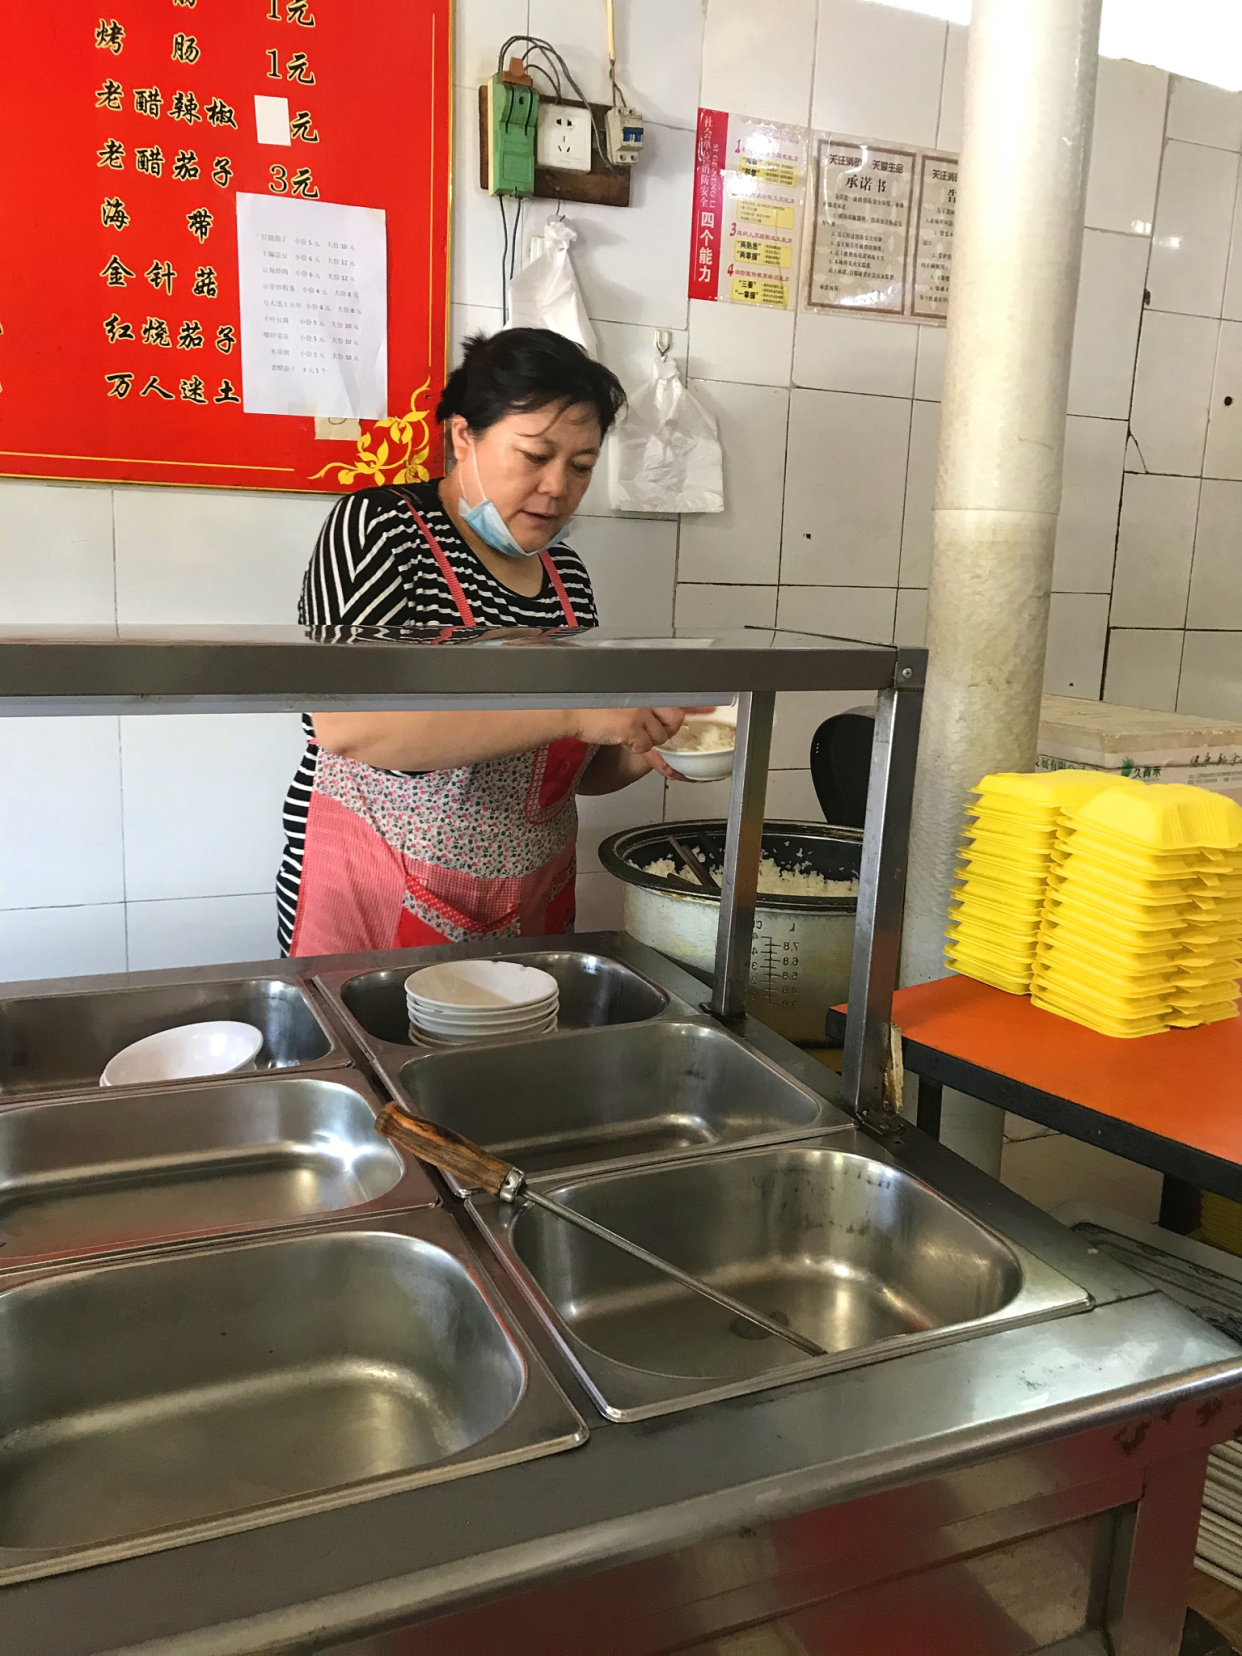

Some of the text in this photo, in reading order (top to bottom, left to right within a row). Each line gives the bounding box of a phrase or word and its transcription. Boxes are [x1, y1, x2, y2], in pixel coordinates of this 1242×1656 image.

[266, 49, 316, 85] 1元
[95, 79, 238, 129] 老醋辣椒
[97, 138, 319, 198] 老醋茄子 3元
[845, 174, 886, 192] 承诺书
[698, 212, 715, 283] 四个能力
[99, 255, 217, 298] 金针菇
[104, 313, 236, 355] 红烧茄子
